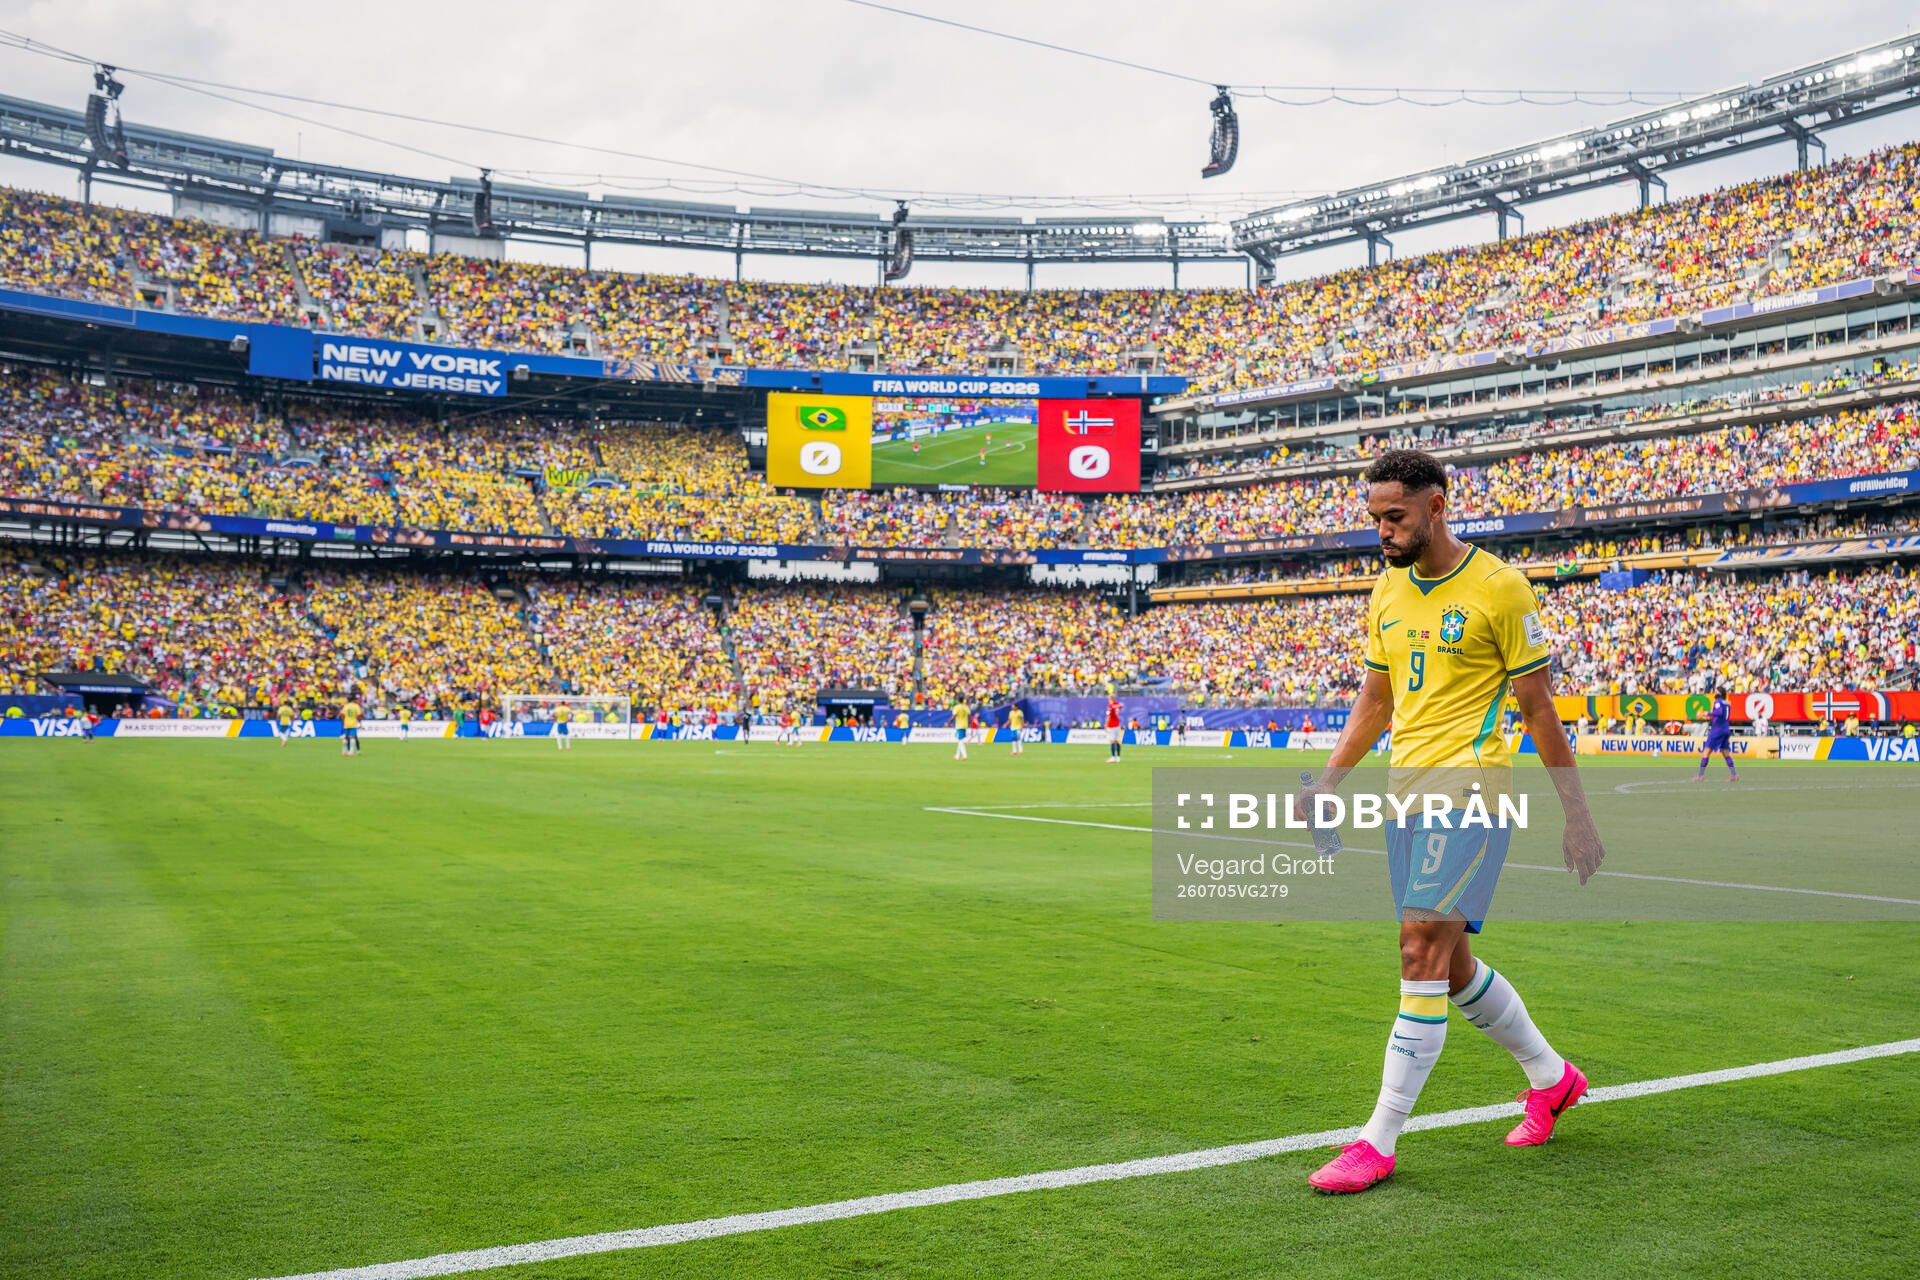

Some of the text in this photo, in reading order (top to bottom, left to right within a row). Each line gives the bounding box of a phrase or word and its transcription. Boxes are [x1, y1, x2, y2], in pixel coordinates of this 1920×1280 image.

[323, 343, 501, 377] NEW YORK
[322, 364, 501, 395] NEW JERSEY
[873, 380, 1040, 395] FIFA WORLD CUP 2026
[1850, 477, 1908, 493] #FIFAWorldCup
[1466, 519, 1504, 533] 2026
[647, 543, 778, 557] FIFA WORLD CUP 2026
[1437, 645, 1464, 655] BRASIL
[1408, 651, 1425, 692] 9
[30, 719, 83, 737] VISA
[268, 719, 316, 737] VSA
[678, 724, 713, 740] VISA
[851, 727, 887, 742] VISA
[1134, 730, 1157, 745] VISA
[1244, 731, 1271, 748] VISA
[1602, 739, 1748, 753] NEW YORK NEW JSEY
[1861, 738, 1919, 761] VISA
[1421, 832, 1448, 875] 9
[1391, 1043, 1418, 1059] BRASIL
